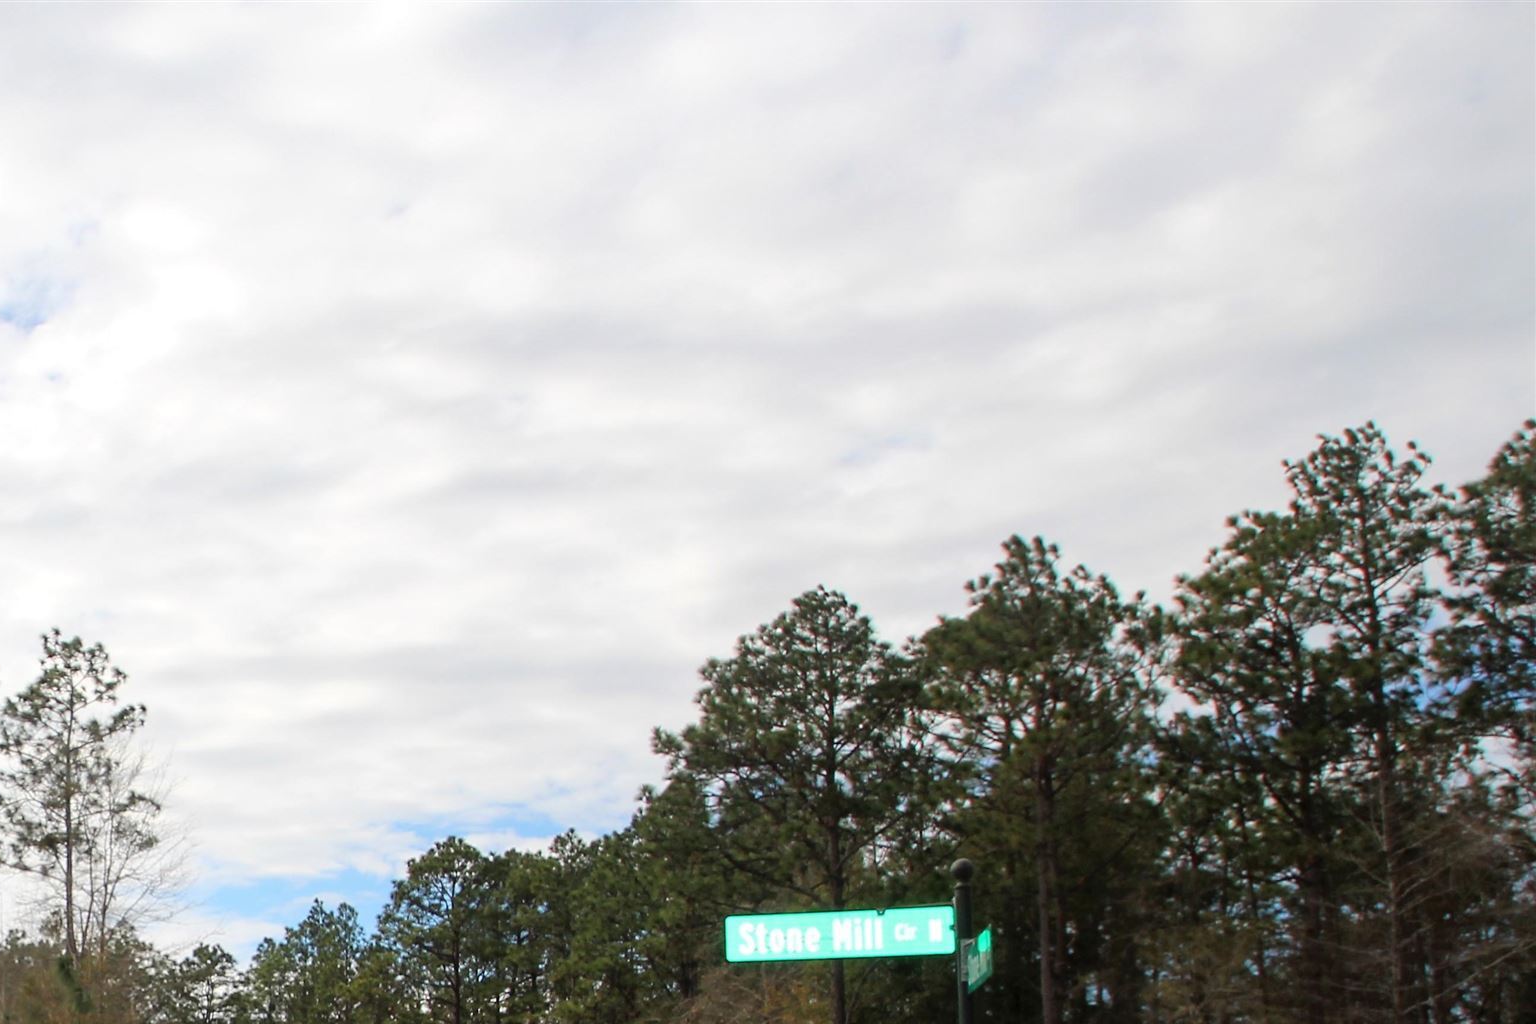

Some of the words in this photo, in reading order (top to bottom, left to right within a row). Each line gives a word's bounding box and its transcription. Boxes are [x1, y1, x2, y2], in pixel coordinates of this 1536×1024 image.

[738, 921, 822, 956] Stone
[831, 917, 884, 951] Mill
[928, 918, 944, 942] N
